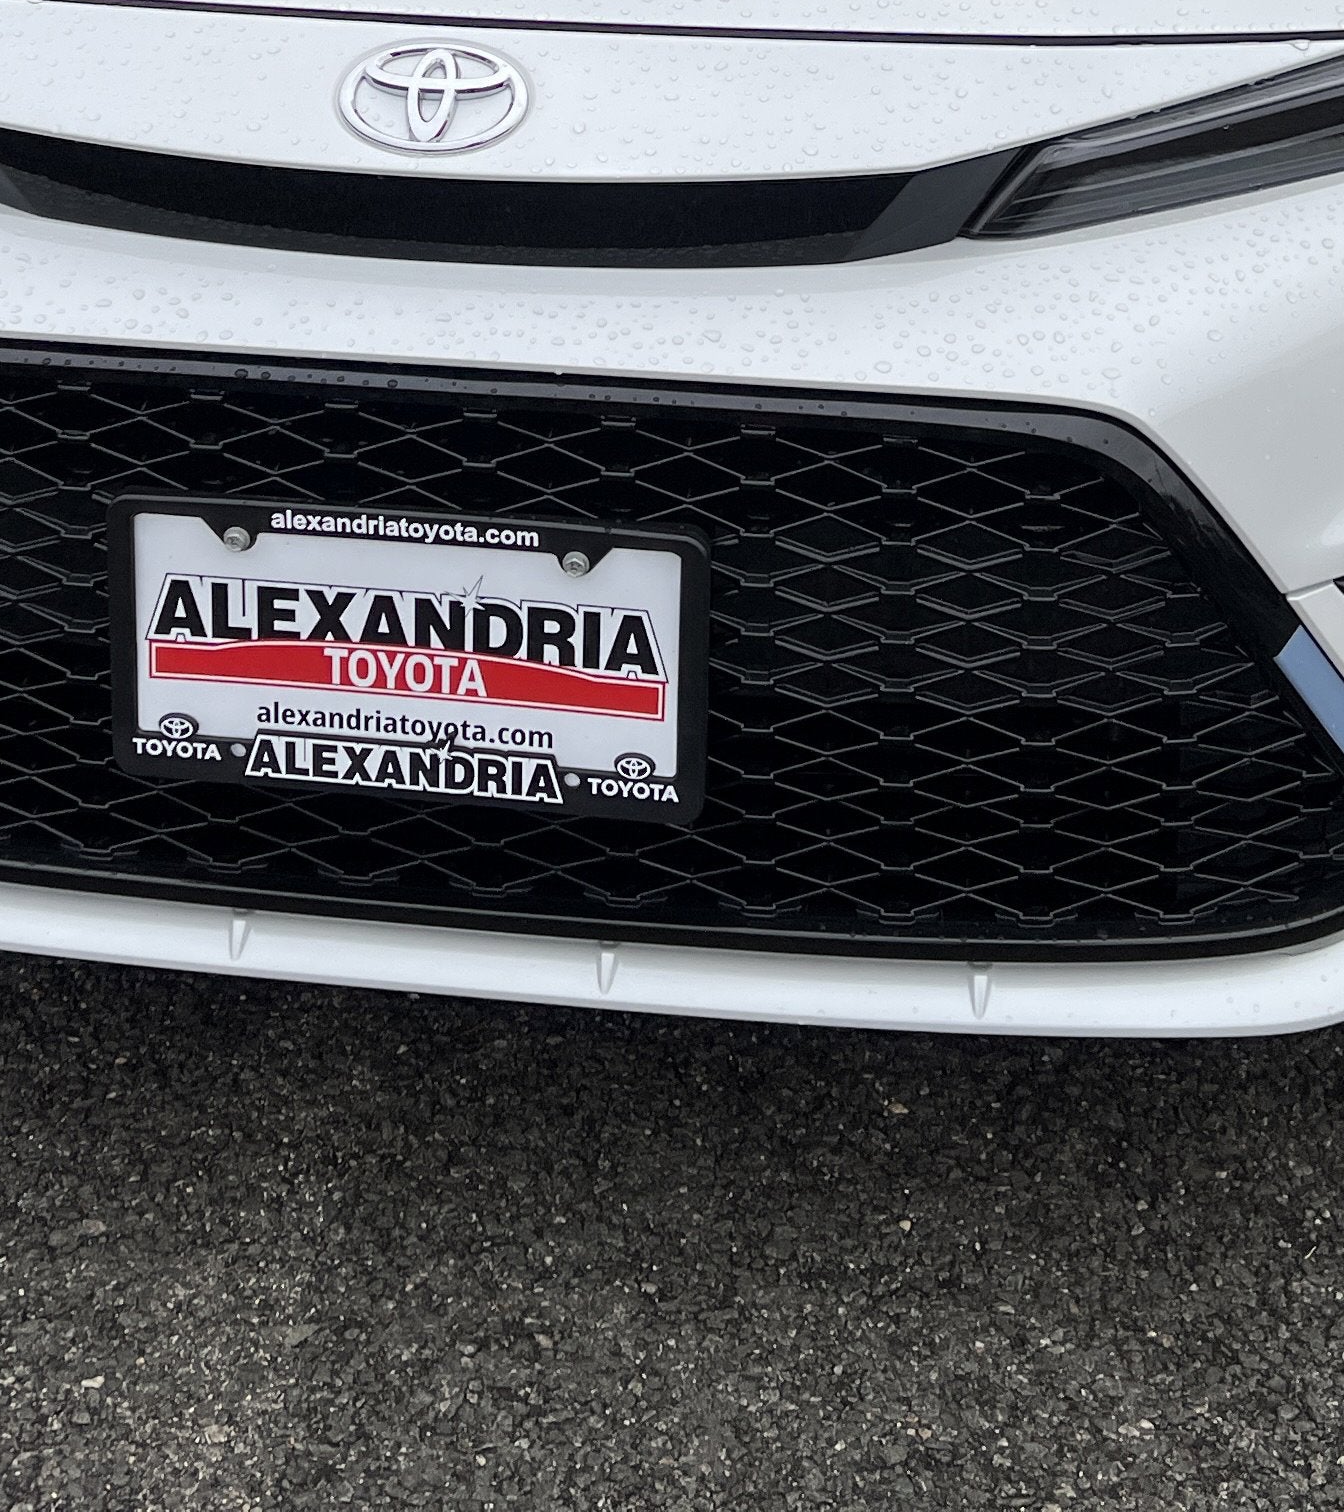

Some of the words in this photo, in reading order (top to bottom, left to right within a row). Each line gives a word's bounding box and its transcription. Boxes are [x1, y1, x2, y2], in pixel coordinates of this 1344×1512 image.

[270, 509, 540, 548] alexandriatoyota.com
[152, 577, 661, 676] ALEXANDRIA
[323, 647, 488, 698] TOYOTA
[132, 737, 222, 761] TOYOTA
[256, 701, 553, 749] alexandriatoyota.com
[247, 736, 563, 805] ALEXANDRIA
[587, 777, 680, 803] TOYOTA
